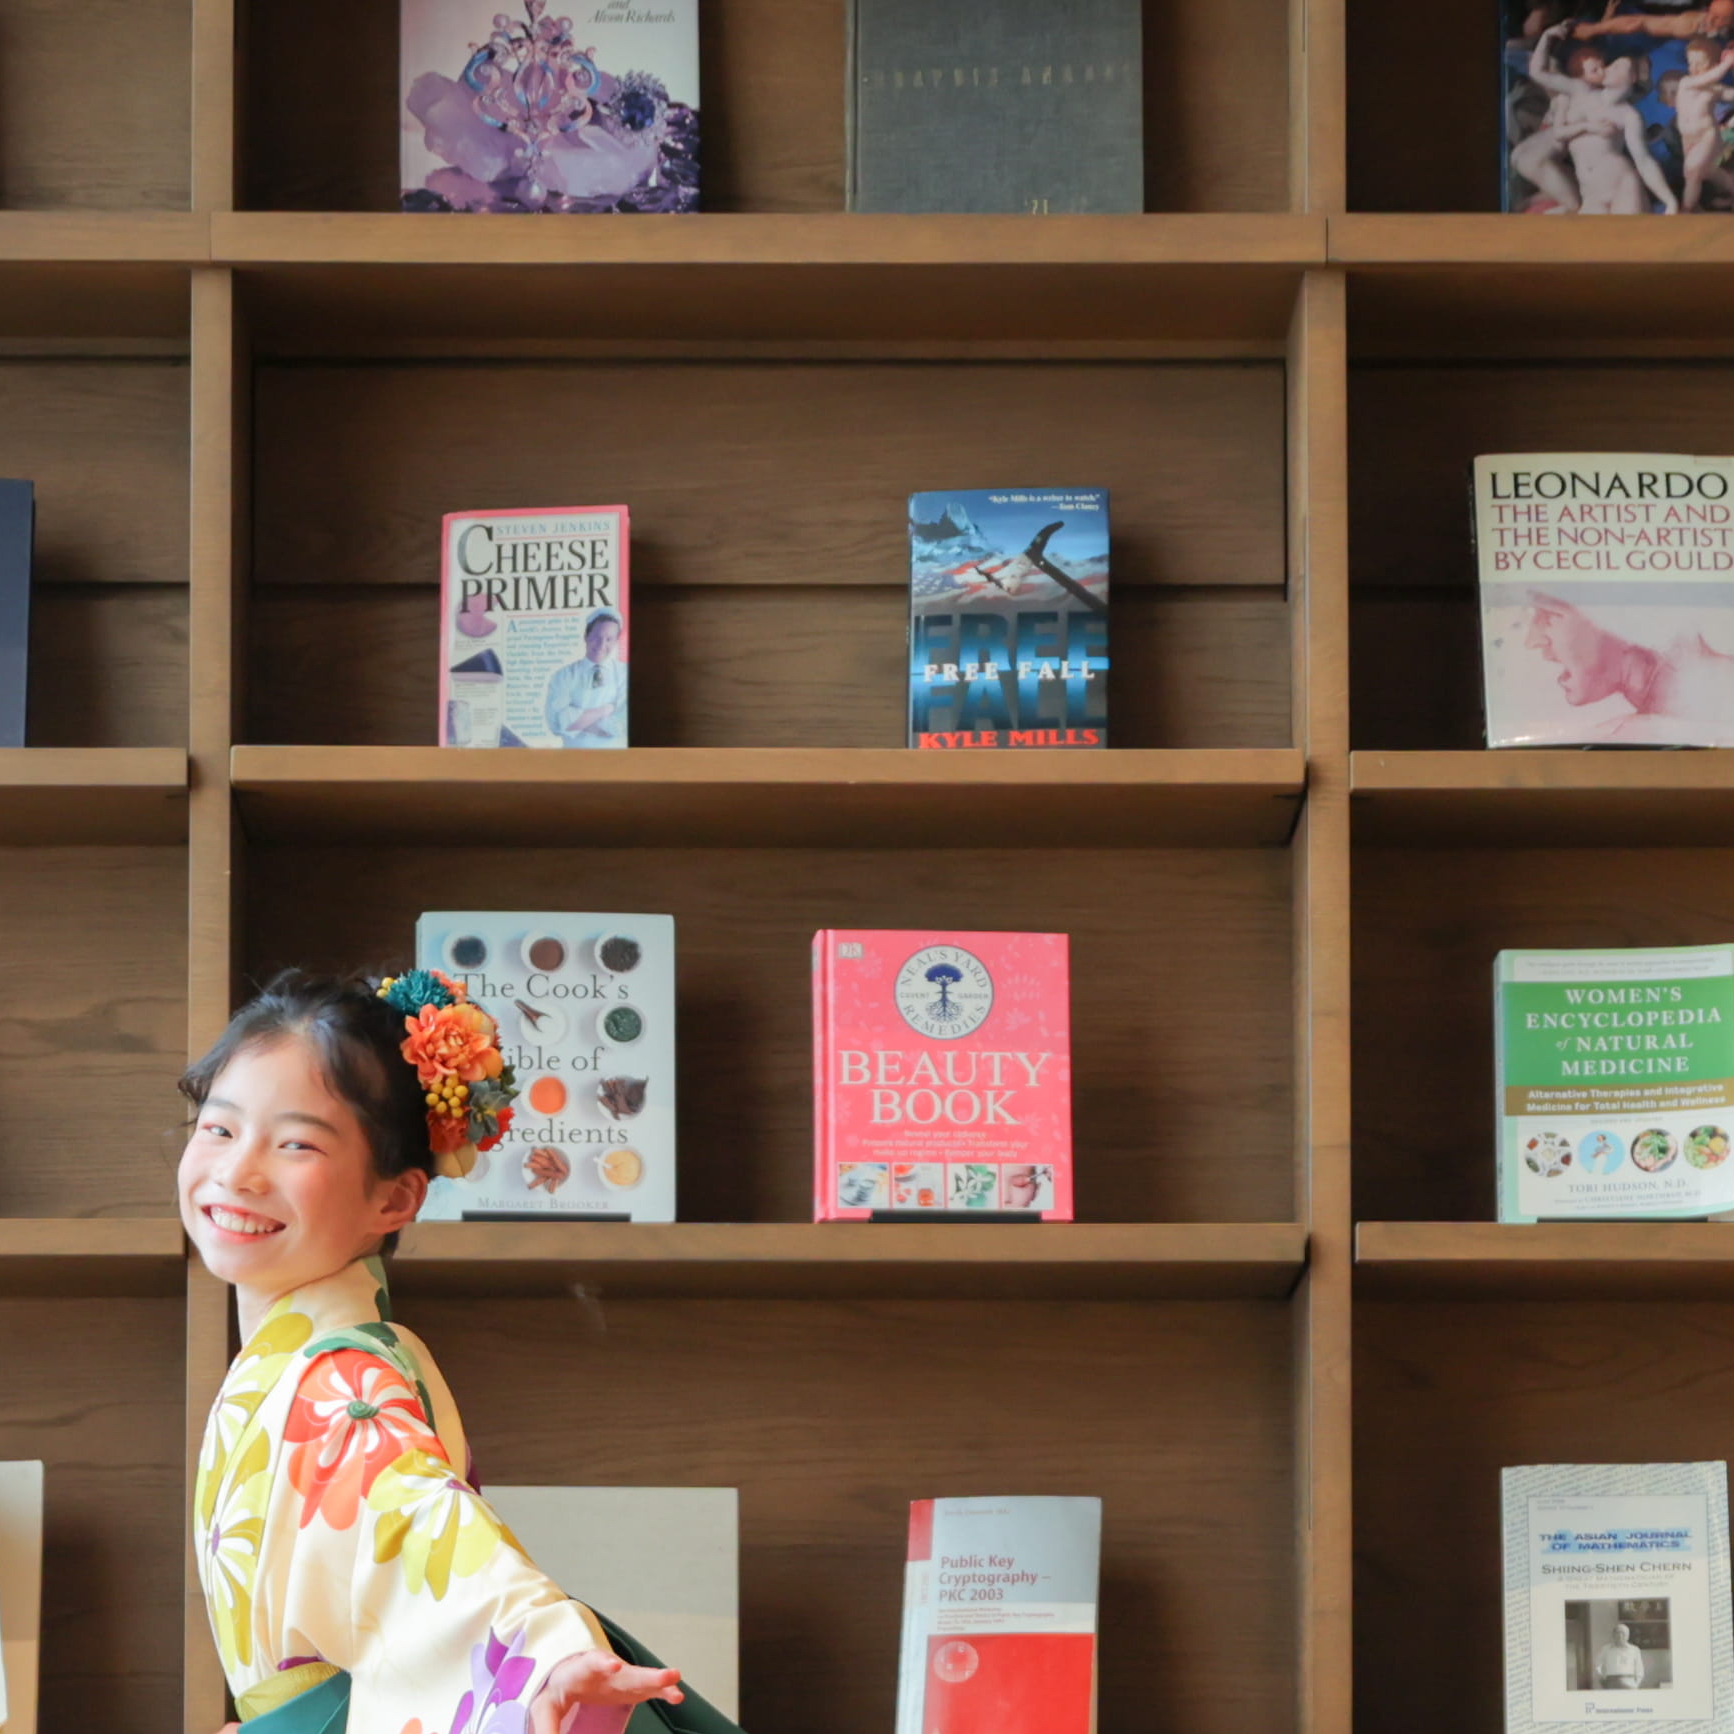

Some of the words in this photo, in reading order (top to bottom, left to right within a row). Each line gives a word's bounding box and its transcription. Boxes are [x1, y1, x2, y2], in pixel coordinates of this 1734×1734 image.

[625, 9, 676, 24] Richards
[1490, 471, 1729, 500] LEONARDO
[1491, 503, 1549, 523] THE
[1557, 503, 1657, 523] ARTIST
[1664, 504, 1731, 523] AND
[495, 522, 548, 536] STEVEN
[552, 519, 611, 533] JENKINS
[1491, 527, 1550, 547] THE
[1557, 526, 1734, 547] NON-ARTIST
[457, 524, 609, 576] CHEESE
[1494, 551, 1527, 571] BY
[1533, 550, 1620, 571] CECIL
[1625, 551, 1734, 571] GOULD
[459, 573, 613, 614] PRIMER
[912, 611, 1109, 675] FREE
[923, 662, 999, 683] FREE
[1017, 660, 1095, 680] FALL
[911, 671, 1108, 733] FALL
[918, 730, 998, 749] KYLE
[1008, 729, 1100, 747] MILLS
[953, 951, 988, 988] YARD
[452, 973, 514, 998] The
[526, 973, 629, 1000] Cook's
[1565, 986, 1682, 1006] WOMEN'S
[903, 1004, 987, 1036] REMEDIES
[1526, 1007, 1721, 1030] ENCYCLOPEDIA
[1556, 1038, 1572, 1050] of
[1576, 1033, 1694, 1052] NATURAL
[508, 1046, 561, 1071] ible
[571, 1046, 604, 1071] of
[839, 1050, 1053, 1087] BEAUTY
[1561, 1056, 1690, 1077] MEDICINE
[1528, 1088, 1588, 1100] Alternative
[1590, 1088, 1641, 1099] Therapies
[1643, 1086, 1662, 1096] and
[1664, 1083, 1724, 1097] Integrative
[870, 1089, 1022, 1125] BOOK
[1526, 1102, 1572, 1112] Medicine
[1574, 1101, 1591, 1111] for
[1594, 1101, 1619, 1111] Total
[1622, 1100, 1657, 1110] Health
[1660, 1098, 1678, 1108] and
[492, 1118, 628, 1151] redients
[477, 1197, 543, 1210] MARGARET
[1540, 1533, 1568, 1541] THE
[1574, 1532, 1618, 1541] ASIAN
[1624, 1531, 1693, 1540] JOURNAL
[1578, 1541, 1681, 1550] MATHEMATICS
[941, 1555, 985, 1569] Public
[988, 1555, 1015, 1571] Key
[1640, 1560, 1692, 1572] CHERN
[939, 1570, 1038, 1586] Cryptography
[939, 1589, 965, 1602] PKC
[970, 1588, 1004, 1602] 2003
